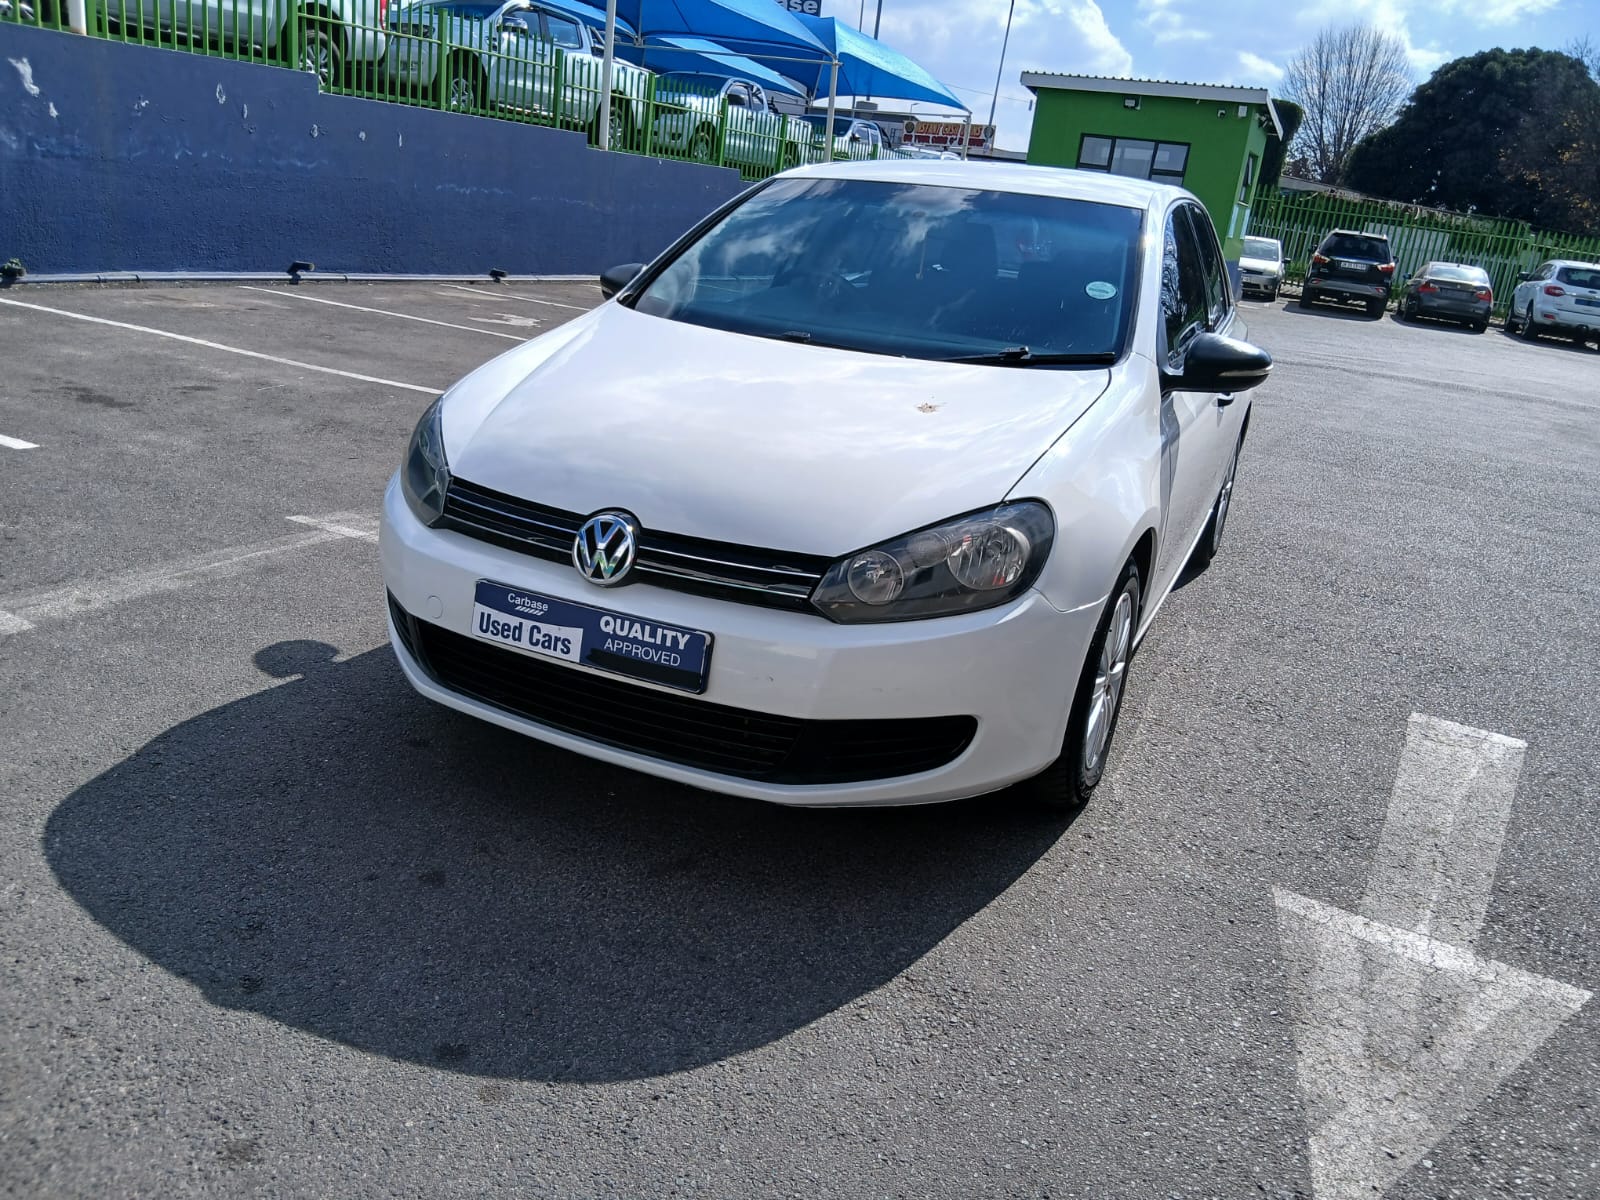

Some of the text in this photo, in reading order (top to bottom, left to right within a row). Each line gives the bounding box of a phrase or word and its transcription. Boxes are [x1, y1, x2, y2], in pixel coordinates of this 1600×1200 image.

[507, 593, 549, 611] Carbase
[479, 611, 572, 655] Used Cars
[600, 615, 690, 650] QUALITY
[604, 638, 681, 666] APPROVED
